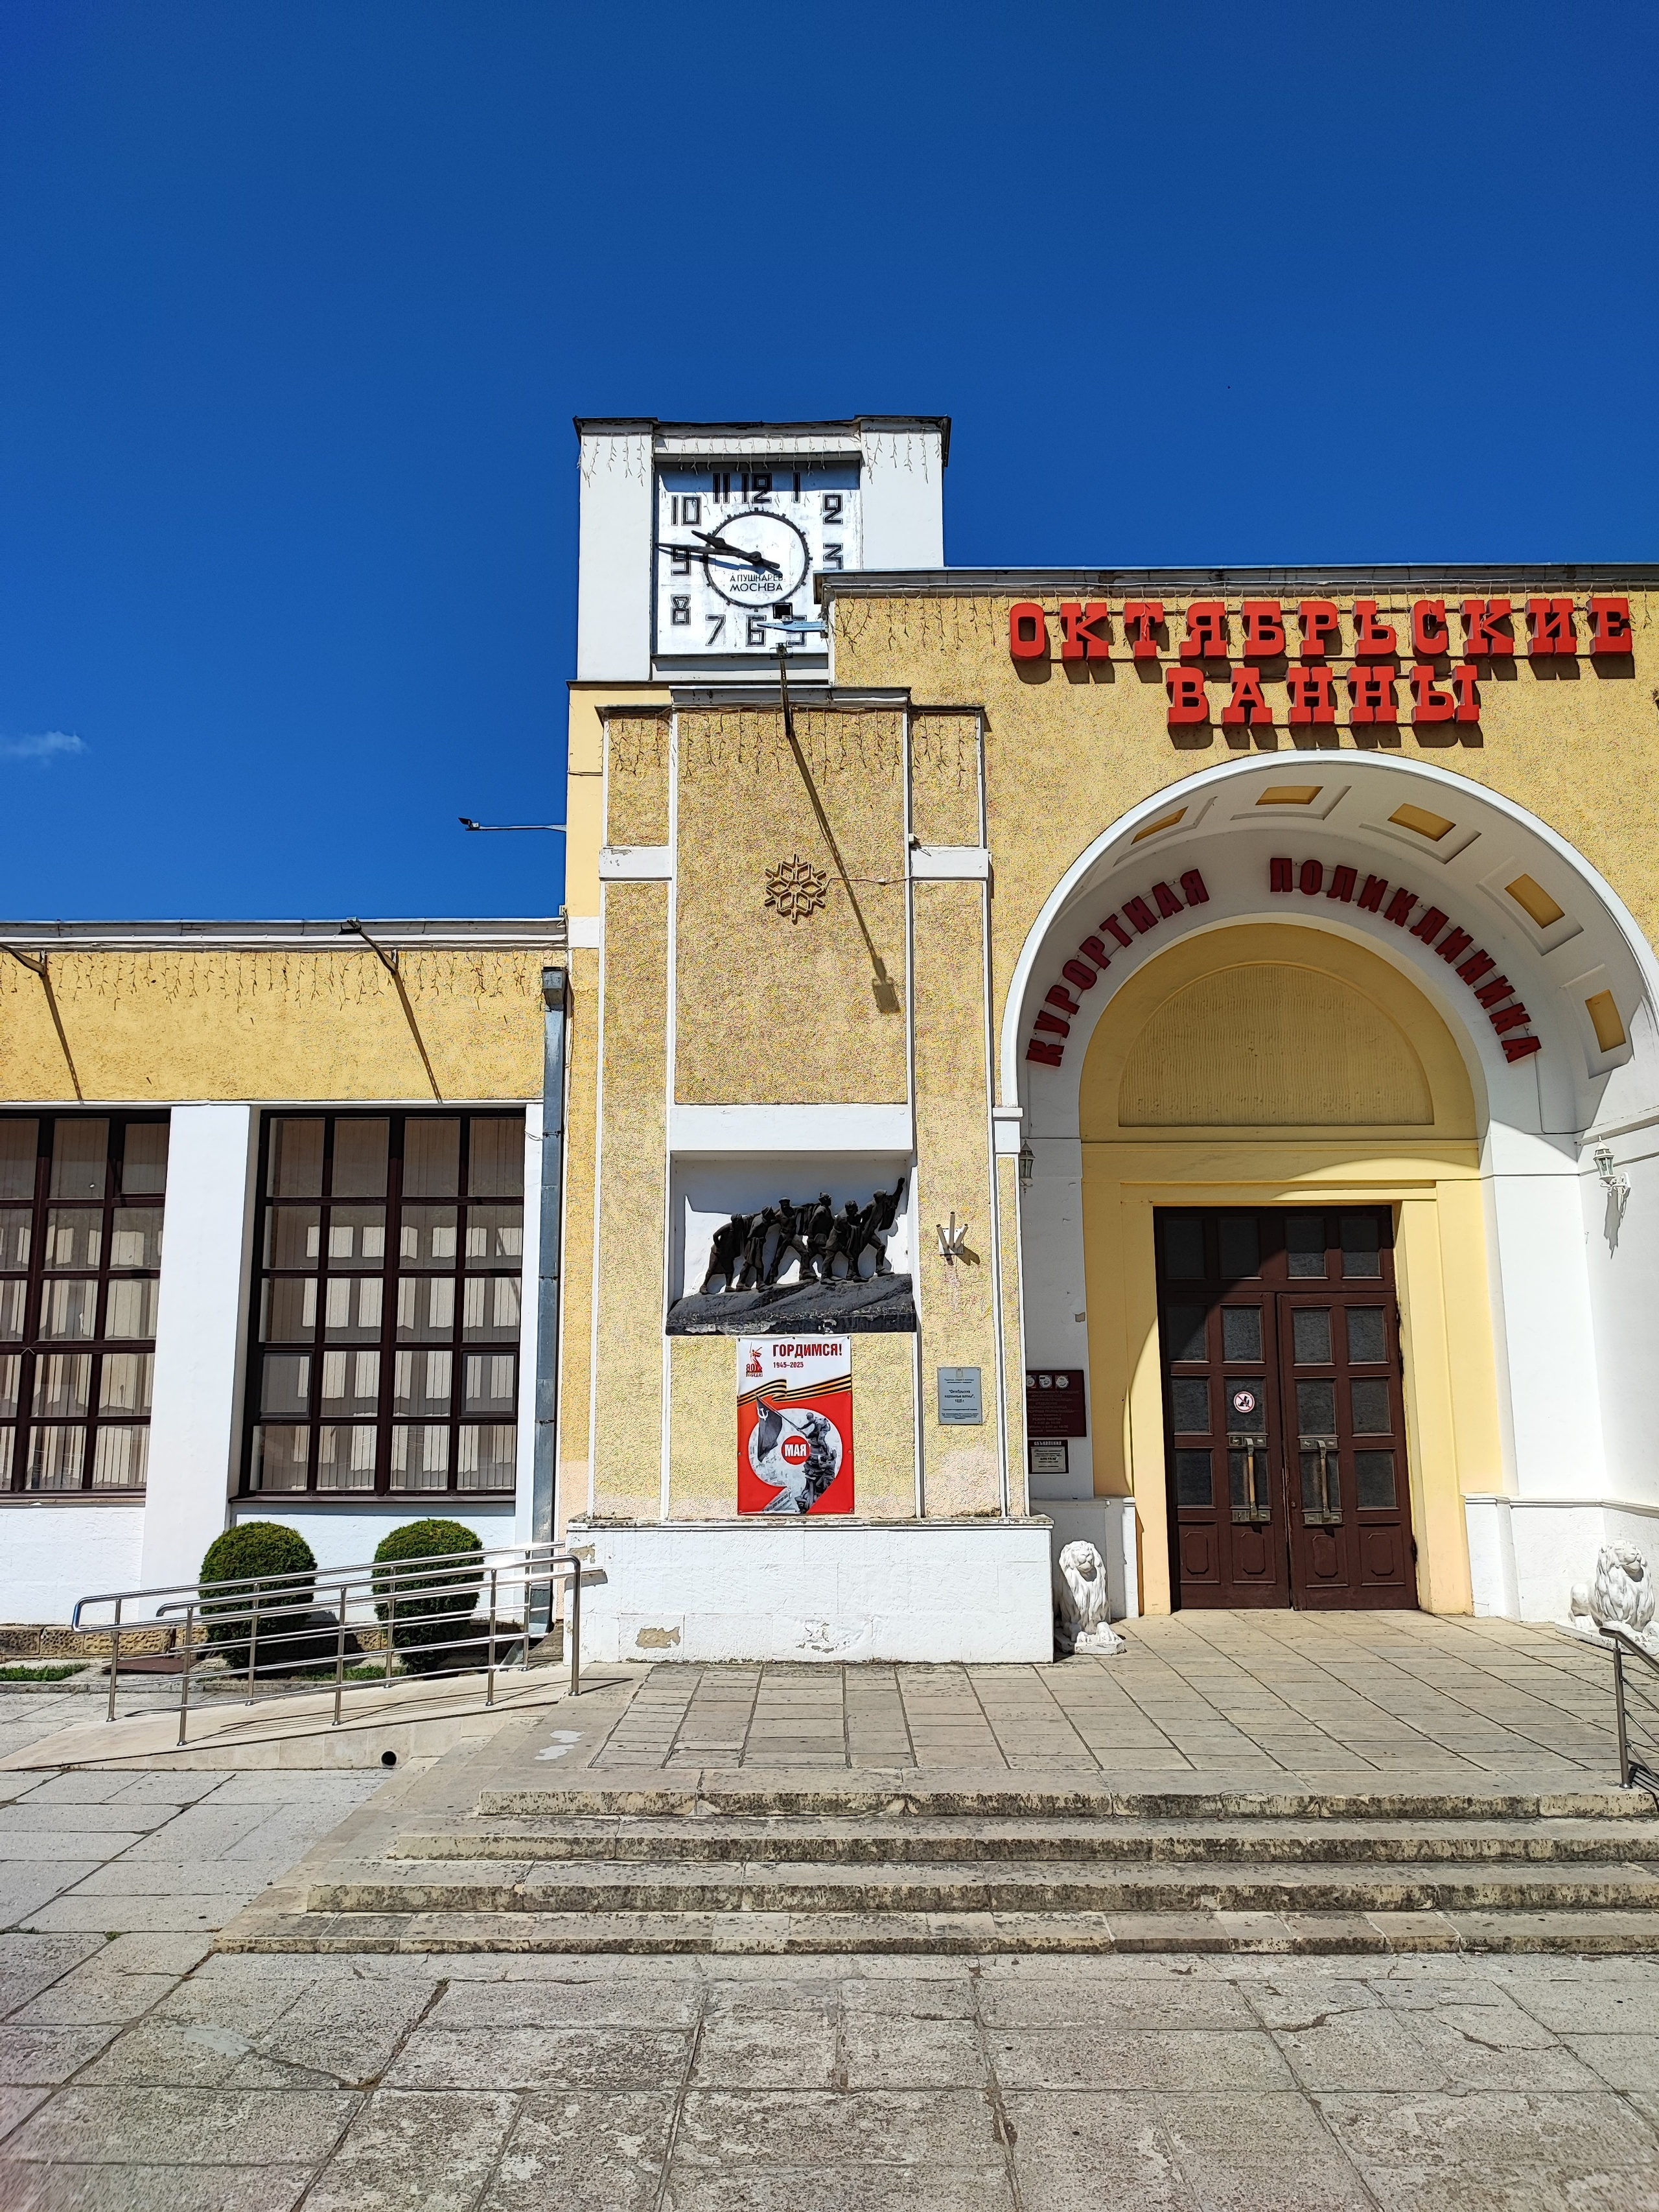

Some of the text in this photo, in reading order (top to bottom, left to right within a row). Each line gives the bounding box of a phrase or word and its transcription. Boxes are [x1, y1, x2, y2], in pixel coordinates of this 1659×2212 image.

[713, 472, 730, 504] 11
[741, 472, 772, 504] 12
[793, 472, 801, 504] 1
[671, 495, 701, 526] 10
[822, 493, 843, 525] 2
[730, 582, 783, 592] МОСКВА
[737, 573, 783, 582] ПУШКАРЕВ
[671, 594, 691, 625] 8
[705, 614, 726, 647] 7
[746, 614, 767, 647] 6
[1008, 597, 1633, 660] ОКТЯБРЬСКИЕ
[1166, 665, 1480, 727] ВАННЫ
[1025, 857, 1542, 1067] КУРОРТНАЯ ПОЛИКЛИНИКА
[772, 1343, 842, 1358] ГОРДИМСЯ!
[784, 1443, 807, 1458] МАЯ
